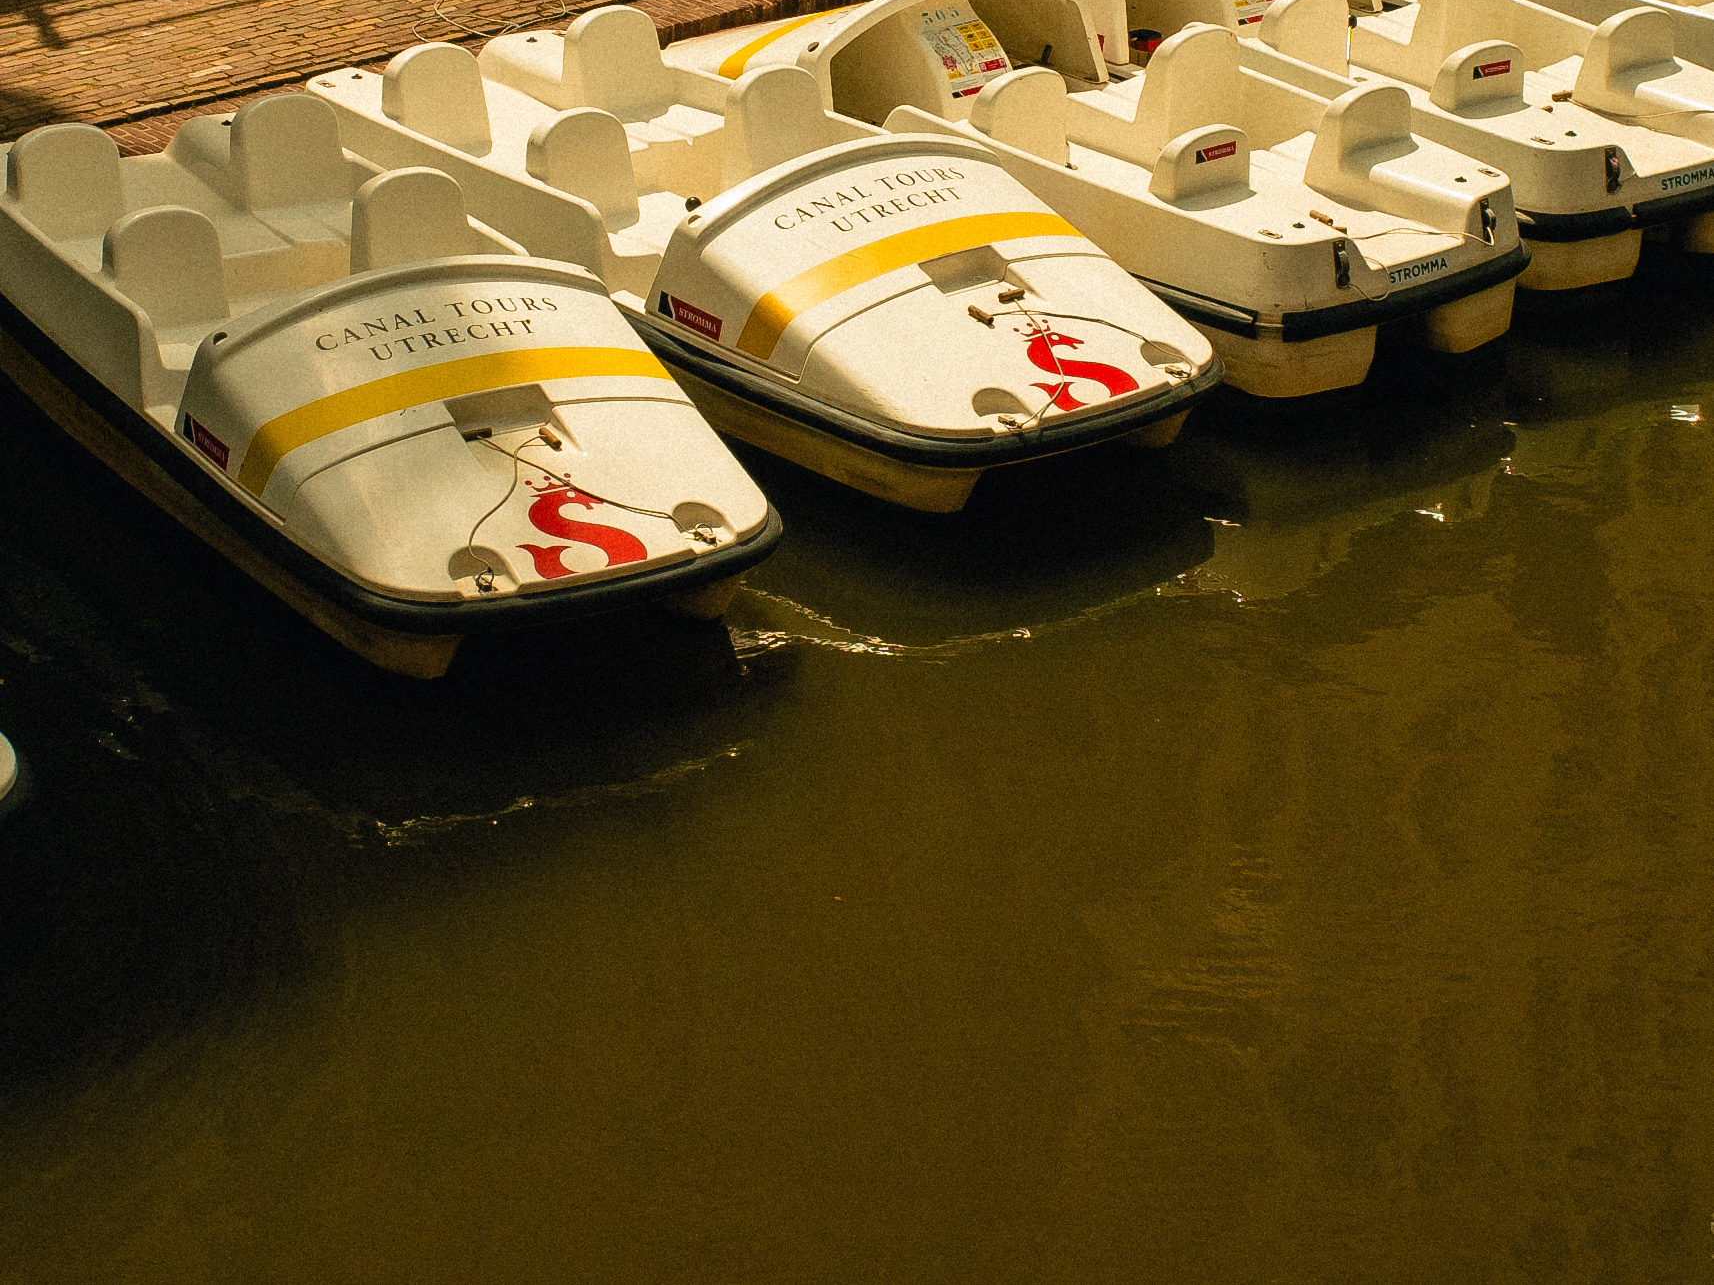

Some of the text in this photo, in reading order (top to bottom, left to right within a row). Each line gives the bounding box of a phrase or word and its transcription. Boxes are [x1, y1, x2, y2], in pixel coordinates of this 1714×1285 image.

[774, 166, 965, 231] CANAL TOURS
[1661, 167, 1714, 191] STROMMA
[829, 187, 963, 232] UTRECHT
[1389, 257, 1449, 284] STROMMA
[315, 296, 559, 351] CANAL TOURS
[369, 319, 536, 361] UTRECHT
[679, 307, 717, 334] STROMMA
